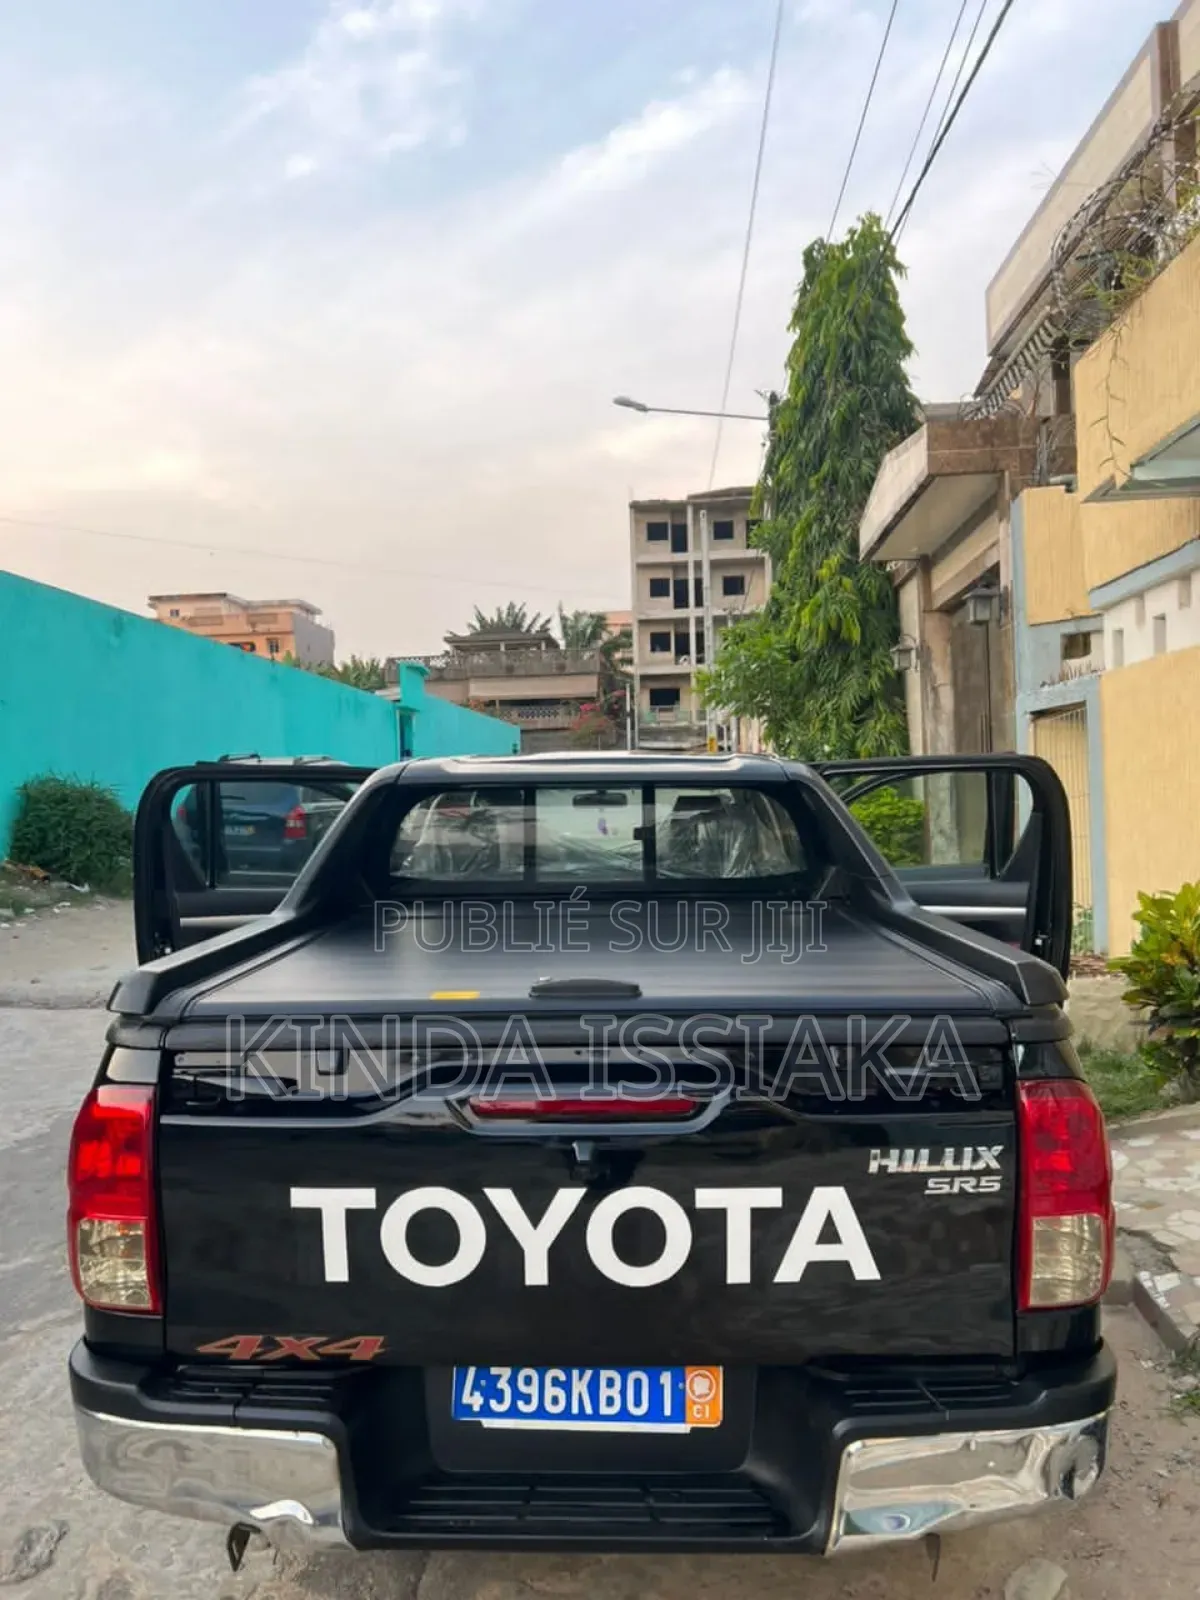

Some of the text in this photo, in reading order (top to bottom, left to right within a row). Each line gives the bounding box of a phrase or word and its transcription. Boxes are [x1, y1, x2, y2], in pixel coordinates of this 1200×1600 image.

[868, 1145, 1004, 1174] HILUX
[924, 1176, 1002, 1195] SR5
[290, 1186, 881, 1287] TOYOTA
[461, 1366, 673, 1417] 4396KB01
